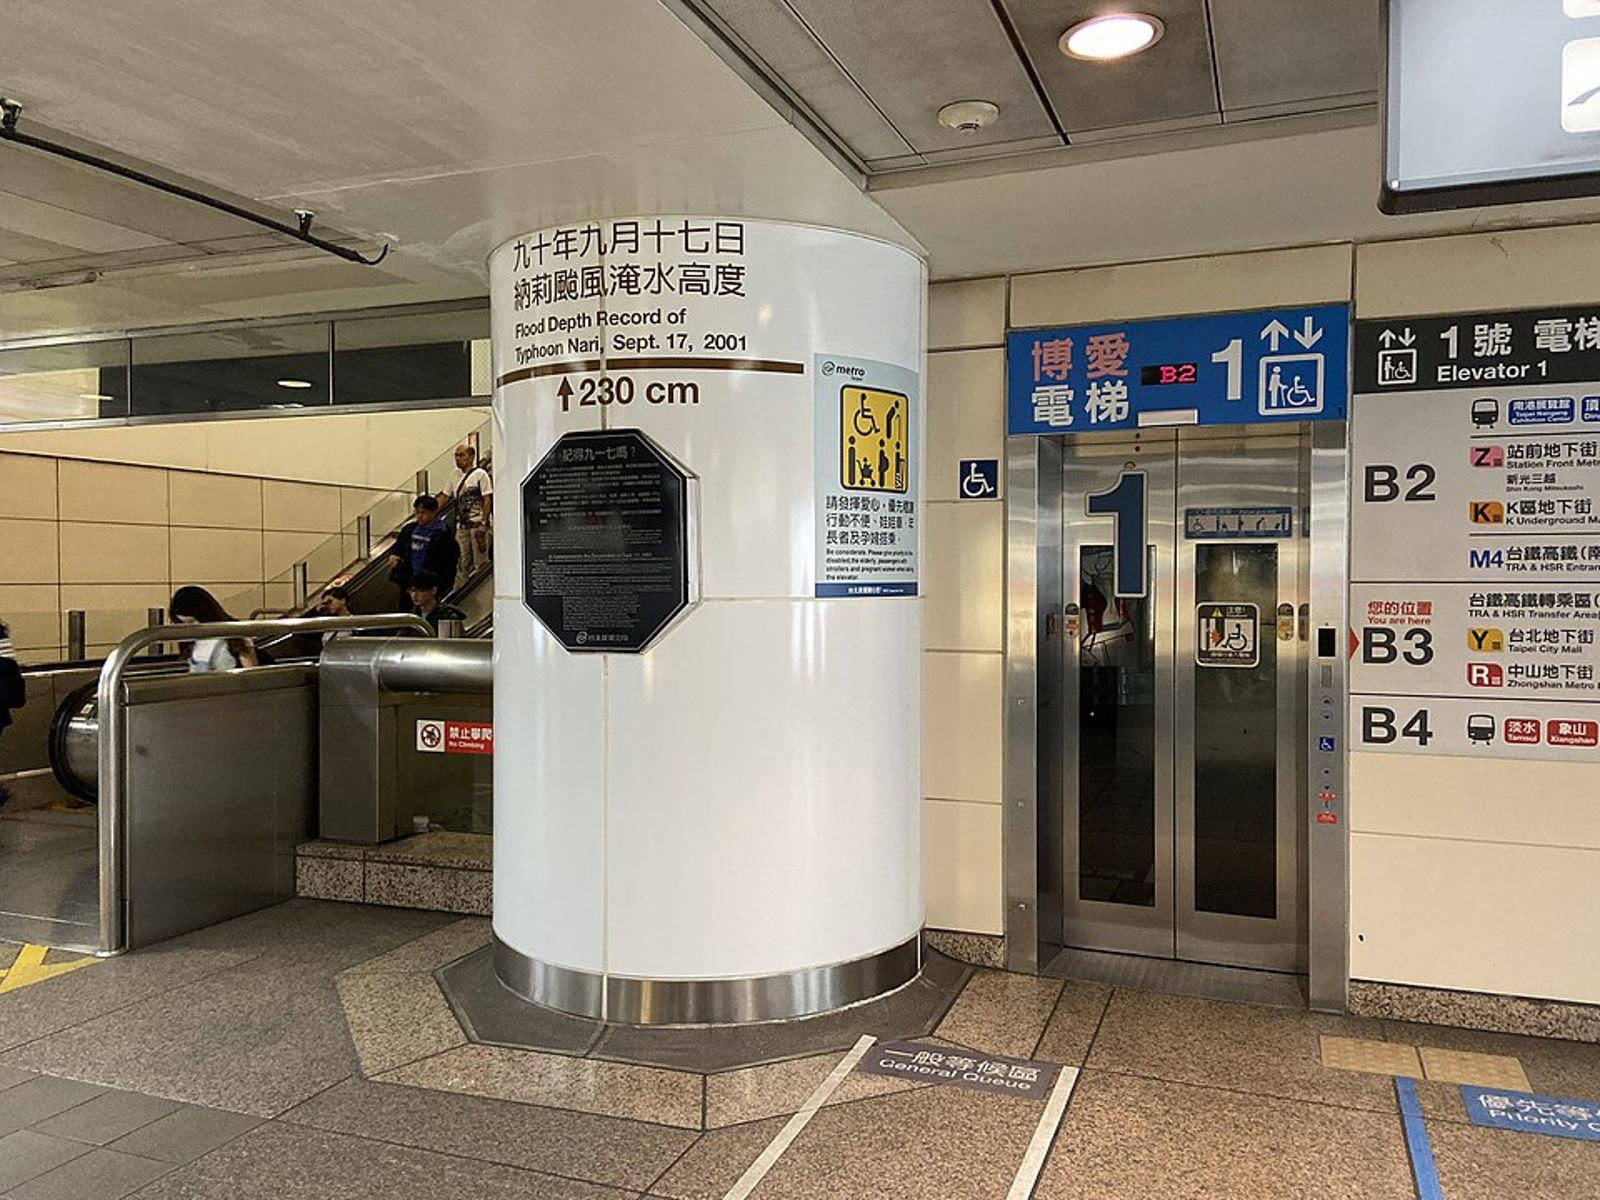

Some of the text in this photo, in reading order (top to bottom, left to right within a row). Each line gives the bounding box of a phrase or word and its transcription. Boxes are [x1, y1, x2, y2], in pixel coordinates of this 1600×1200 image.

[513, 219, 745, 273] 九十年九月十七日
[513, 261, 746, 311] 納莉颱風淹水高度
[515, 308, 687, 340] Flood Depth Record of
[515, 333, 747, 365] Typhoon Nari, Sept. 17, 2001
[1031, 332, 1131, 381] 博愛
[836, 366, 865, 377] metro
[1160, 365, 1196, 383] B2
[1211, 339, 1242, 400] 1
[1437, 360, 1547, 382] Elevator 1
[578, 377, 700, 406] 230 cm
[1031, 380, 1130, 427] 電梯
[1507, 442, 1598, 460] 站前地下街
[1506, 461, 1543, 469] Station
[1546, 460, 1574, 468] Front
[1364, 464, 1436, 502] B2
[1507, 500, 1591, 515] K區地下街
[1516, 515, 1585, 526] Underground
[1086, 472, 1147, 597] 1
[1470, 550, 1504, 568] M4
[1506, 563, 1527, 571] TRA
[1529, 563, 1538, 571] &
[1541, 563, 1563, 571] HSR
[1368, 616, 1387, 624] You
[1408, 616, 1430, 624] here
[1468, 610, 1490, 618] TRA
[1492, 609, 1499, 618] &
[1503, 610, 1526, 618] HSR
[1529, 610, 1570, 619] Transfer
[1363, 627, 1433, 665] B3
[1509, 629, 1593, 643] 台北地下街
[1508, 645, 1537, 654] Taipei
[1539, 645, 1558, 654] City
[1561, 645, 1582, 653] Mall
[1508, 664, 1593, 680] 中山地下街
[1508, 680, 1561, 690] Zhongshan
[1565, 681, 1594, 689] Metro
[1362, 707, 1433, 745] B4
[879, 1059, 1031, 1091] General Queue
[884, 1049, 1041, 1083] 一般等候區
[1489, 1108, 1578, 1131] Priority
